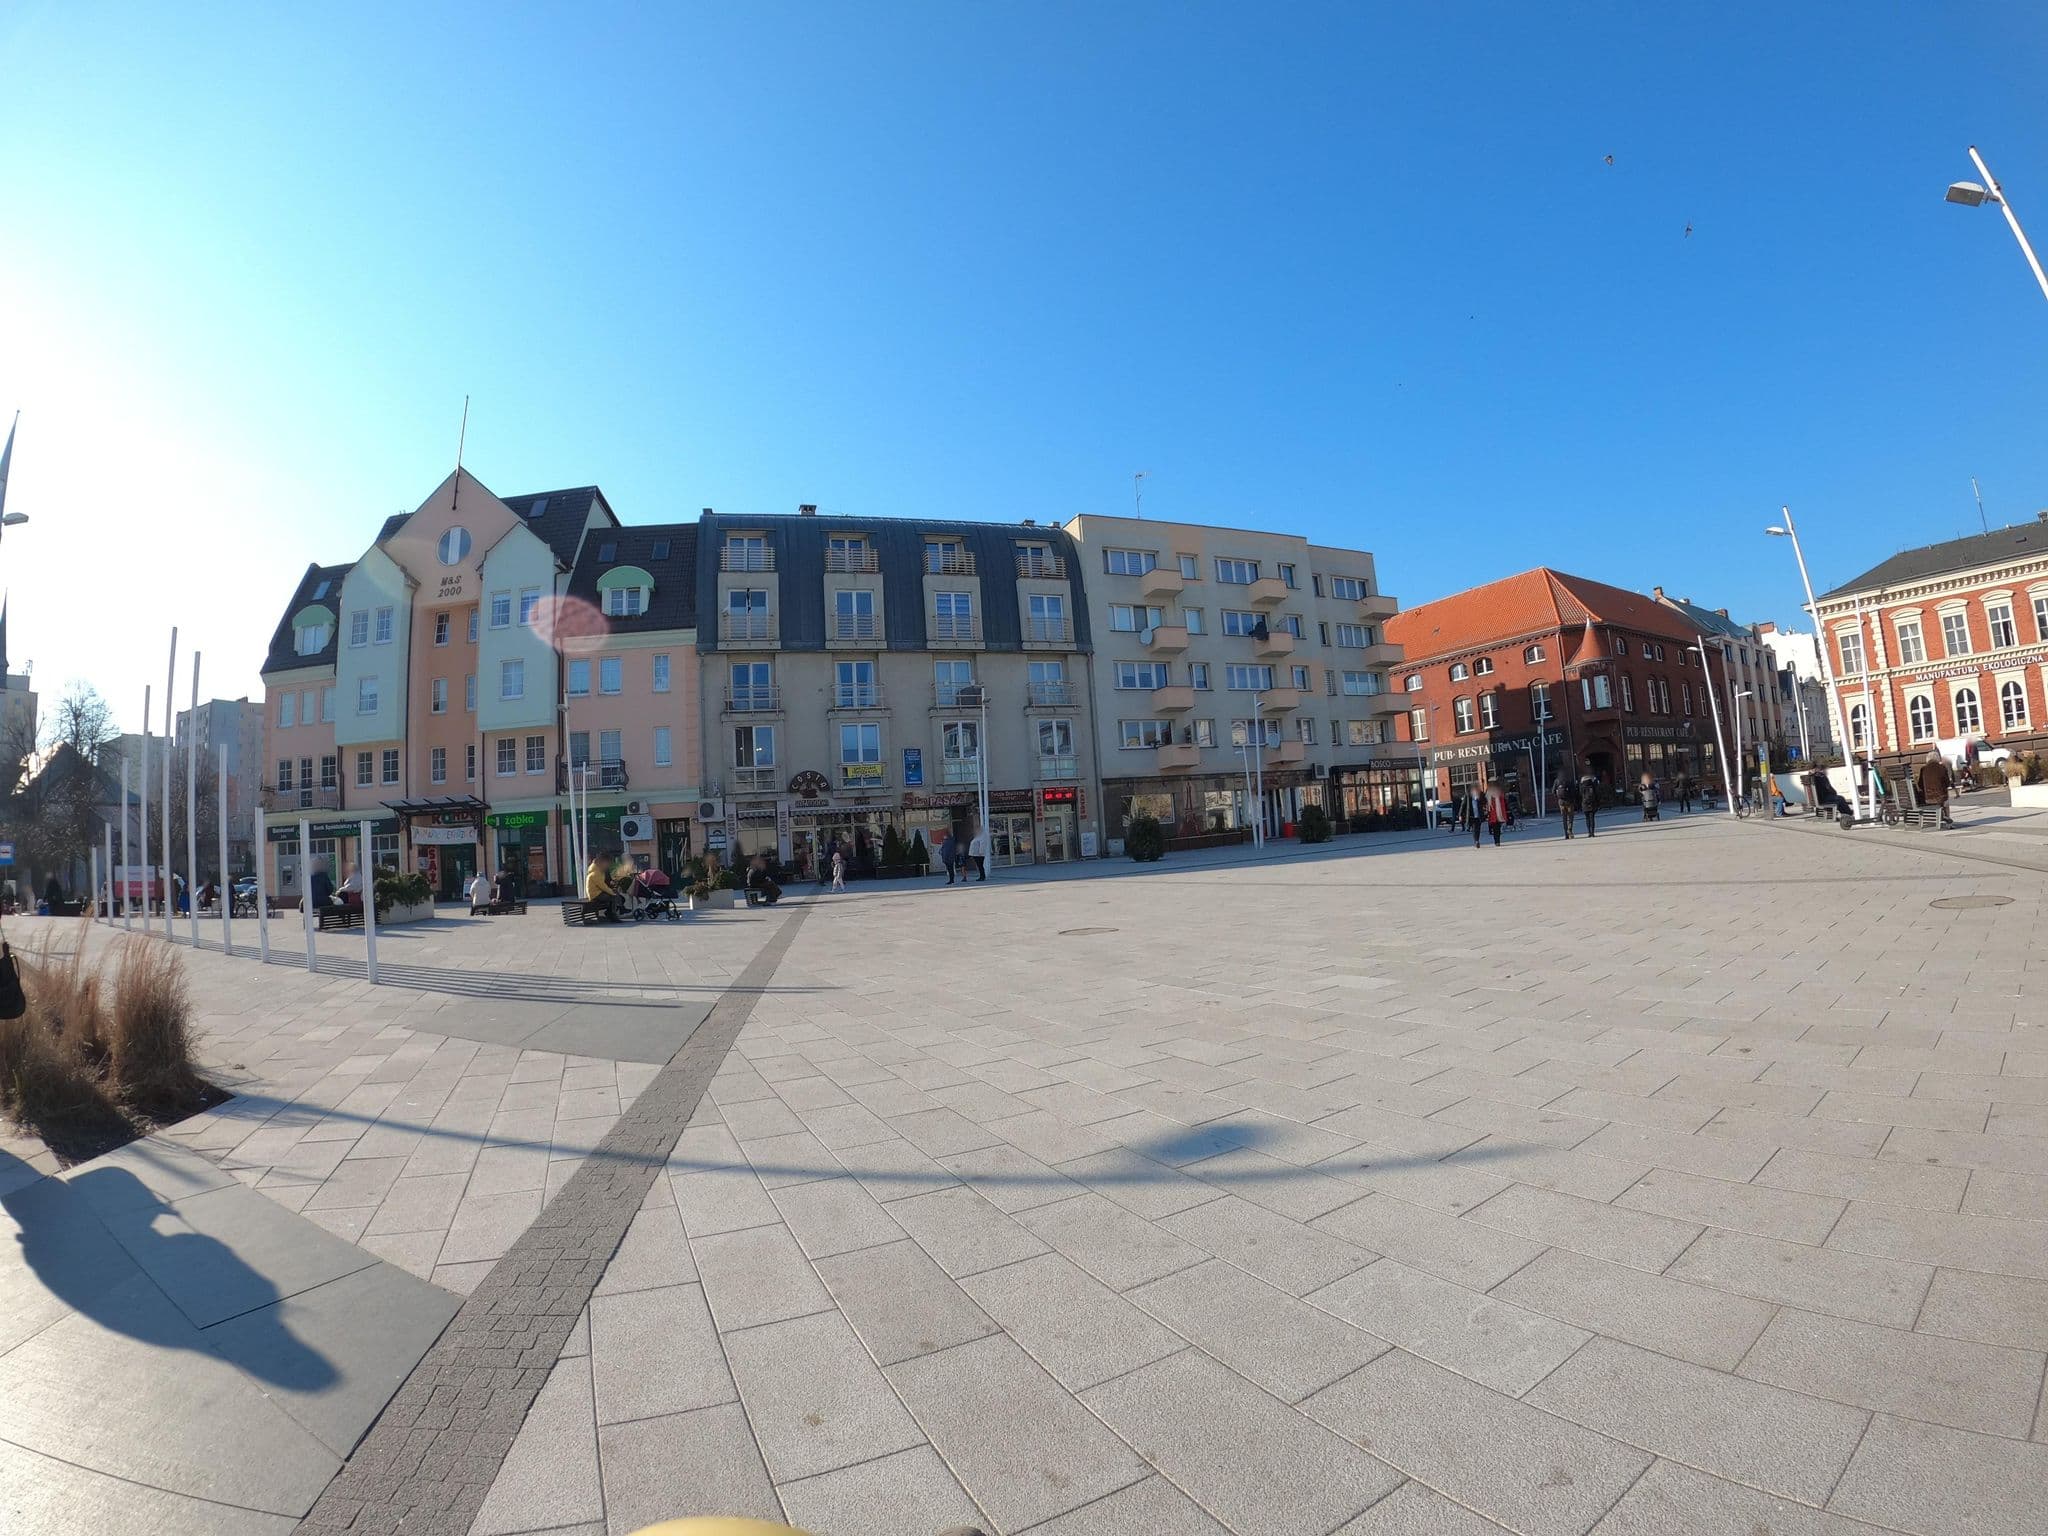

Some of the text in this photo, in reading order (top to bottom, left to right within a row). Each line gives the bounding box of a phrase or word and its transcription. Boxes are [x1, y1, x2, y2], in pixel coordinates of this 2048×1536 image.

[441, 575, 461, 586] M&S
[438, 586, 462, 597] 2000
[1915, 655, 2044, 681] MANUFAKTURA EKOLOGICZNA
[1532, 733, 1564, 747] CAFE
[792, 772, 828, 790] COSTA
[504, 815, 534, 825] żabka
